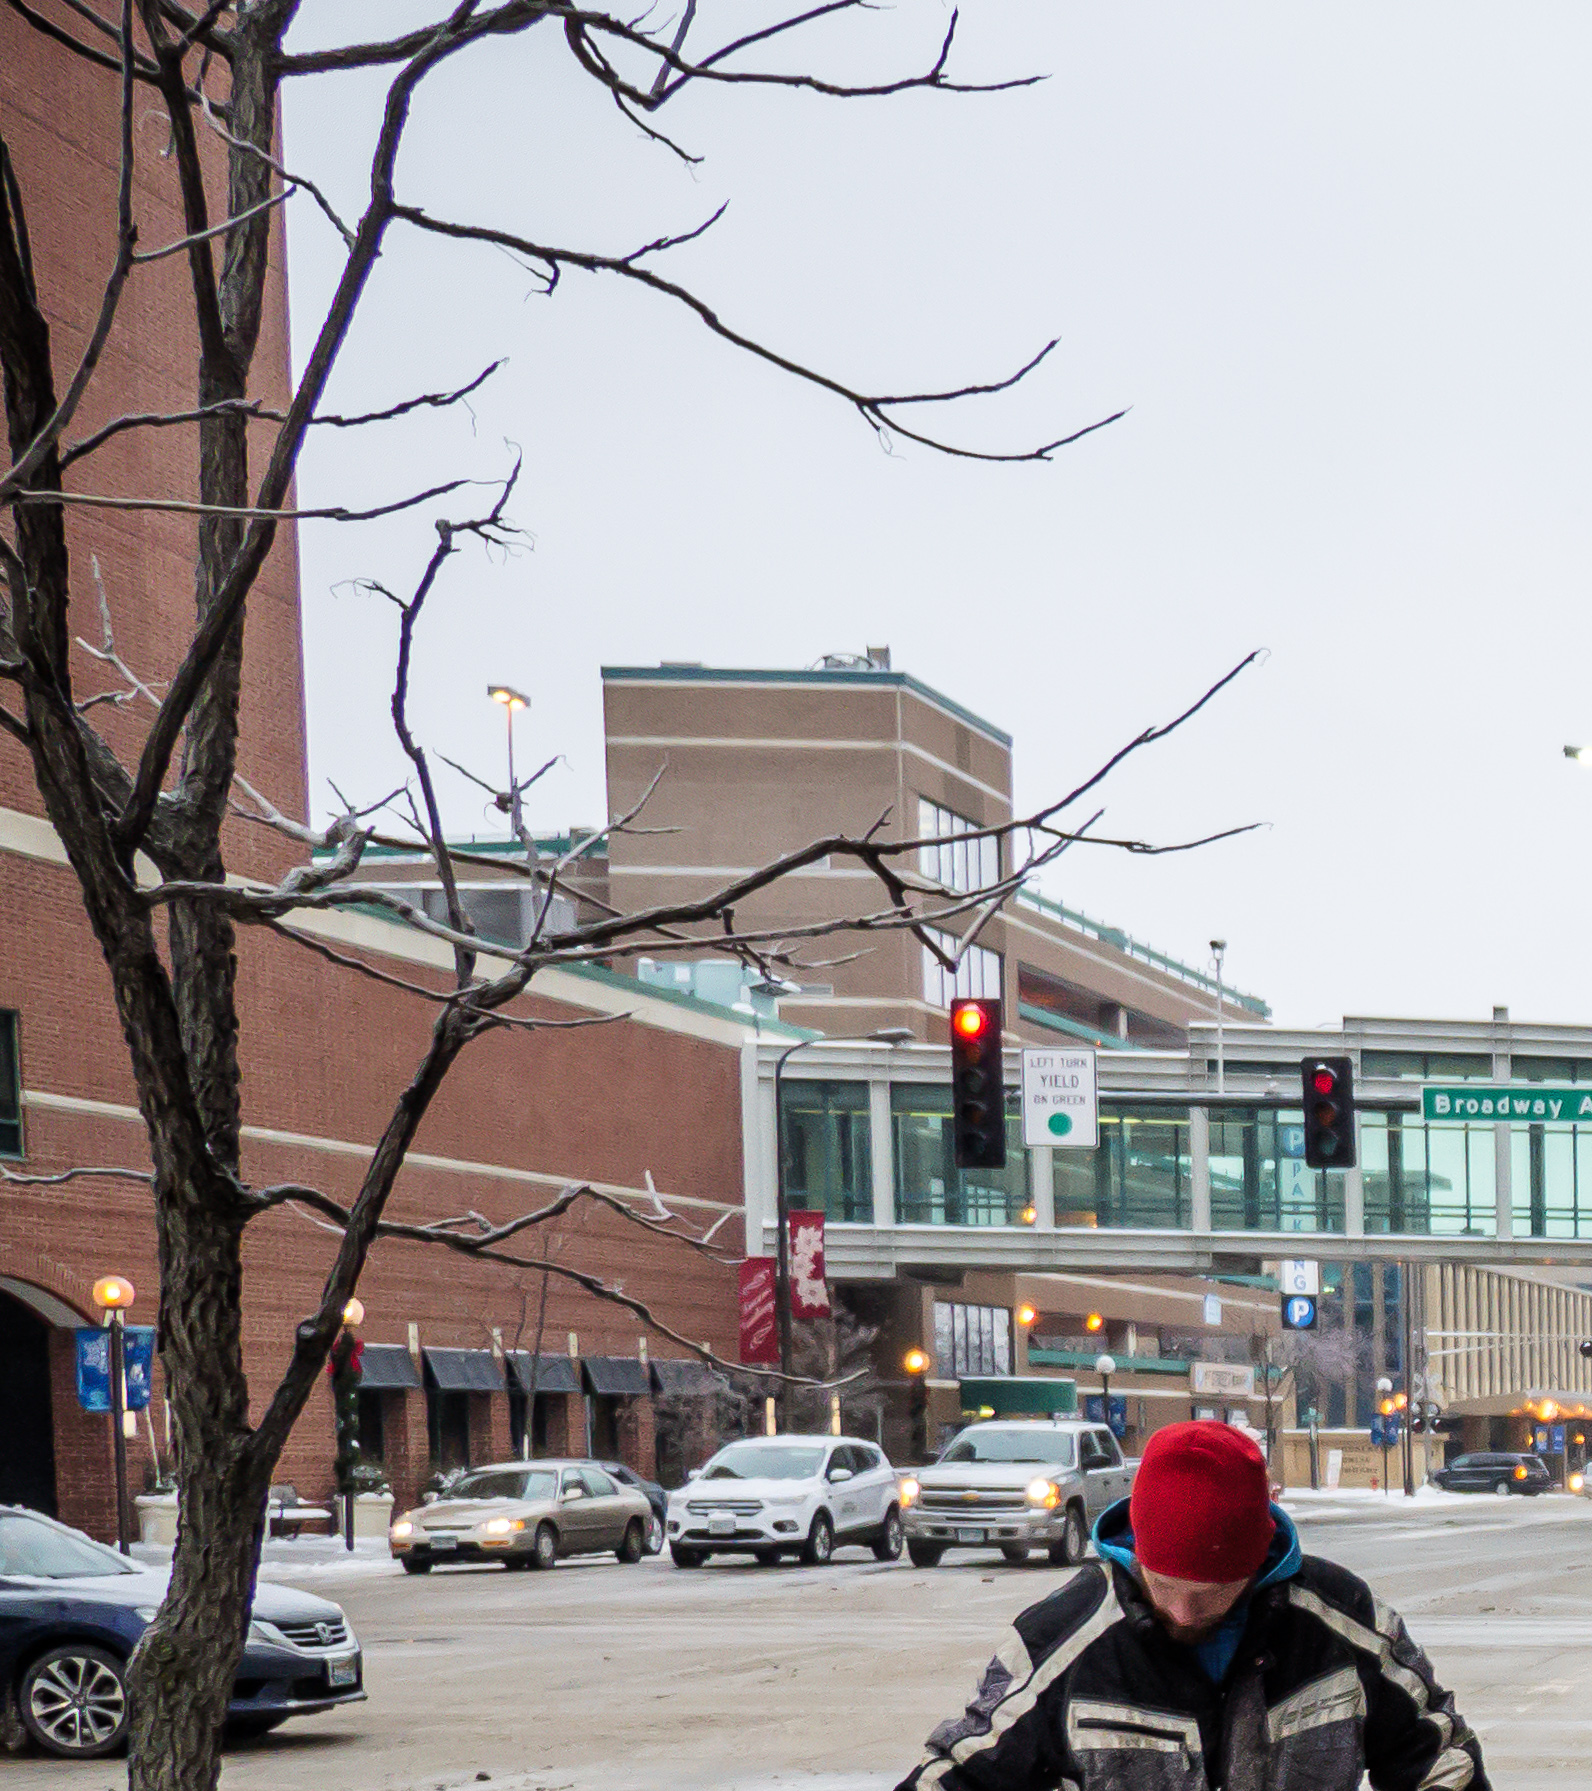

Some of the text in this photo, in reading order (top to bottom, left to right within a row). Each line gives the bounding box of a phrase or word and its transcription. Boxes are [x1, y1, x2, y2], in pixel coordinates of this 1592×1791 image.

[1041, 1075, 1079, 1088] YIELD
[1434, 1093, 1563, 1119] Broadway
[1293, 1302, 1310, 1323] P
